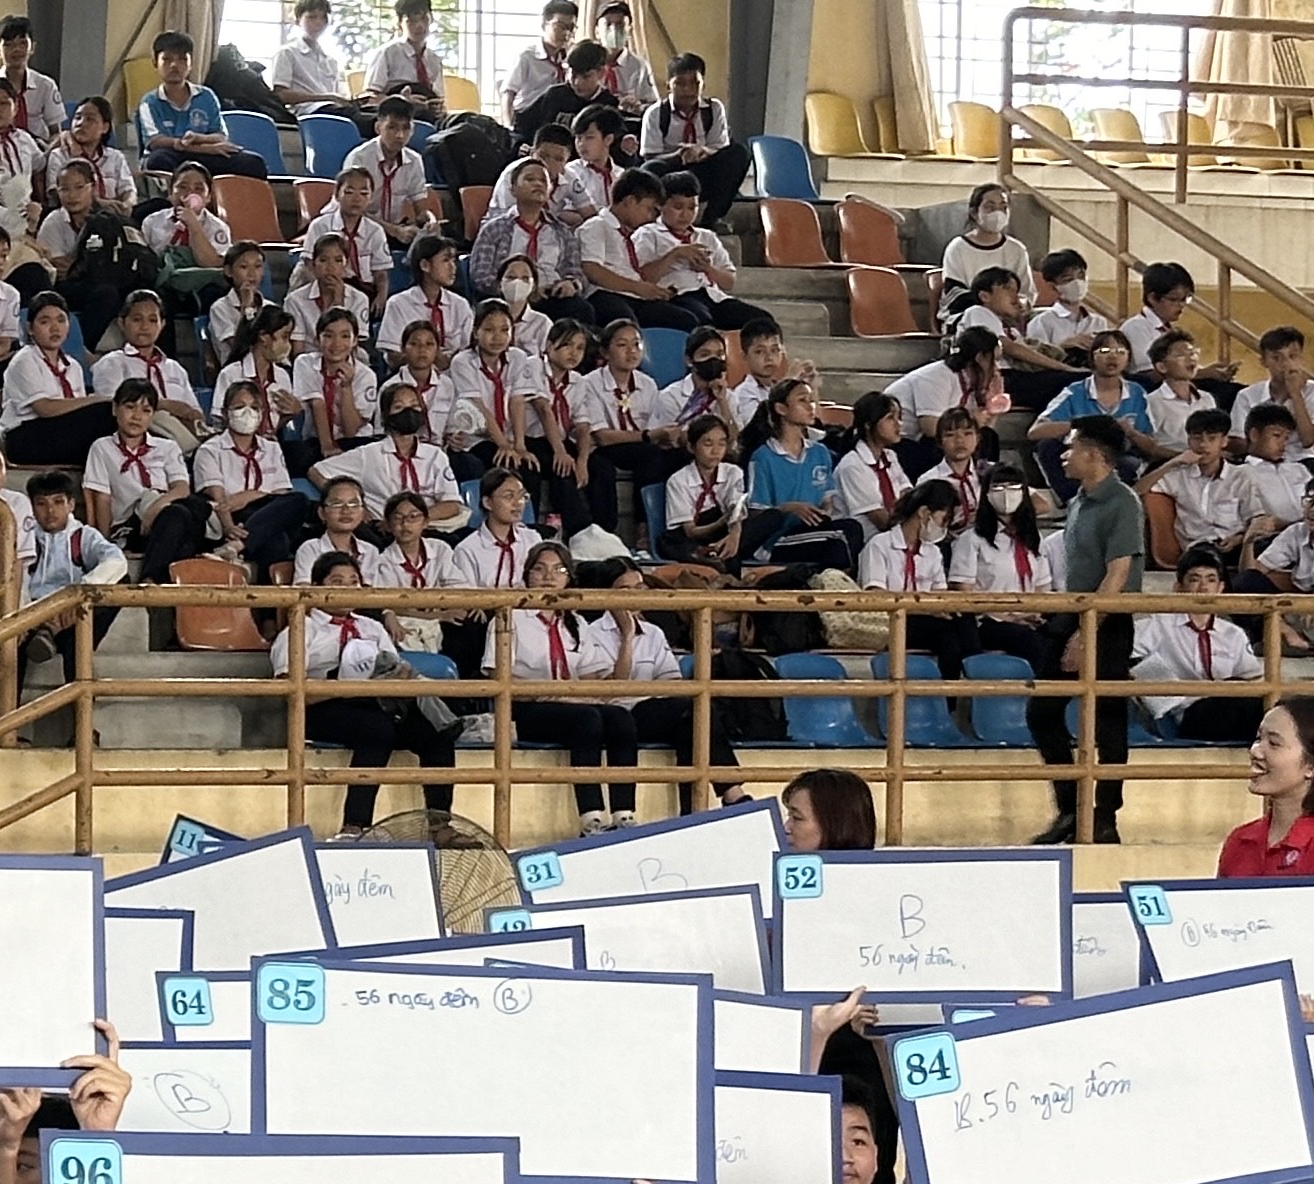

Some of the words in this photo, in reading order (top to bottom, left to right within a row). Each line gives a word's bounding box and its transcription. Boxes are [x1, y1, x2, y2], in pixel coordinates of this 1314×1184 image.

[526, 861, 557, 883] 31
[784, 866, 818, 890] 52
[899, 894, 926, 938] B
[1138, 895, 1166, 917] 51
[859, 944, 884, 967] 56
[171, 989, 207, 1015] 64
[266, 978, 316, 1011] 85
[355, 989, 381, 1006] 56
[905, 1047, 952, 1086] 84
